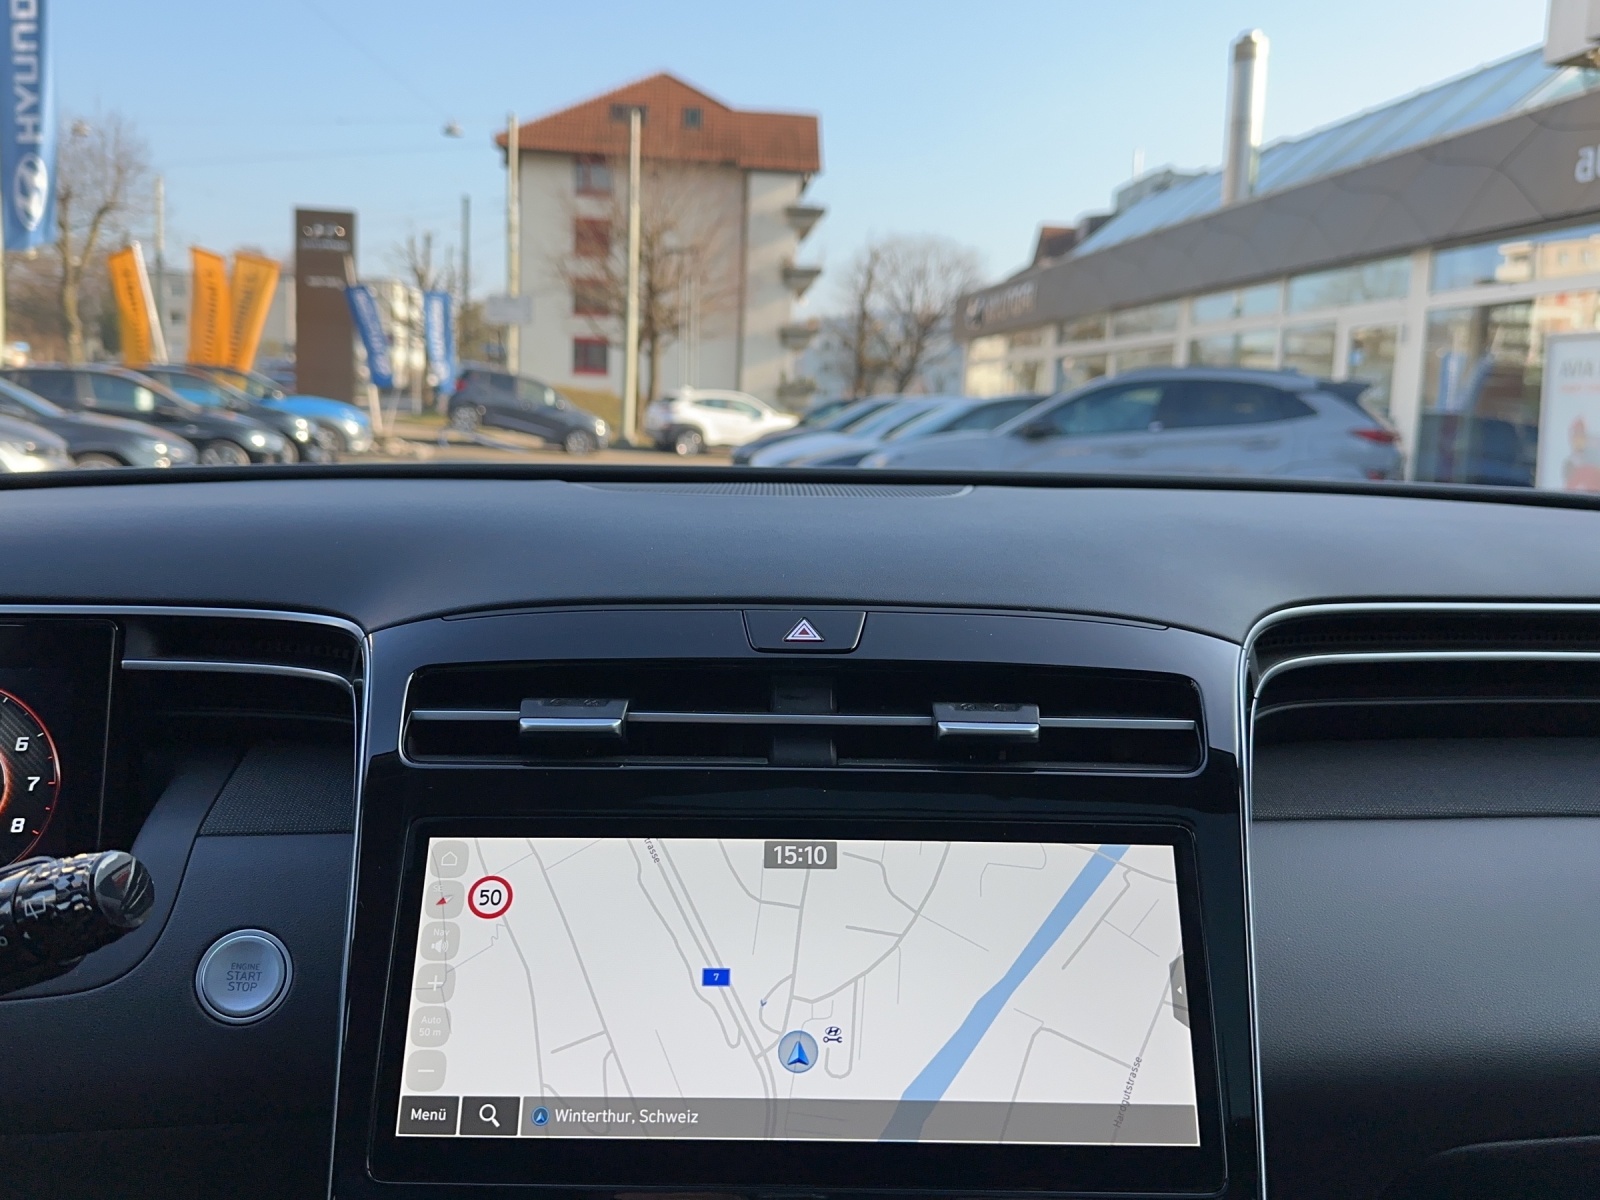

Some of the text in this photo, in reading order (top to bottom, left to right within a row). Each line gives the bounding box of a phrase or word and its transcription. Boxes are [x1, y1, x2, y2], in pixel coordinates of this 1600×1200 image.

[1574, 144, 1600, 183] a
[15, 736, 29, 752] 6
[27, 776, 40, 791] 7
[10, 817, 26, 833] 8
[773, 845, 827, 865] 15:10
[479, 889, 502, 906] 50
[433, 928, 450, 936] Nav
[230, 962, 260, 971] ENGINE
[226, 970, 262, 981] START
[713, 973, 719, 981] 7
[227, 981, 257, 992] STOP
[421, 1015, 442, 1025] Auto
[419, 1028, 430, 1037] 50
[1112, 1056, 1142, 1128] Hardgutstrasse
[410, 1107, 446, 1121] Menü
[554, 1108, 699, 1124] Winterthur, Schweiz
